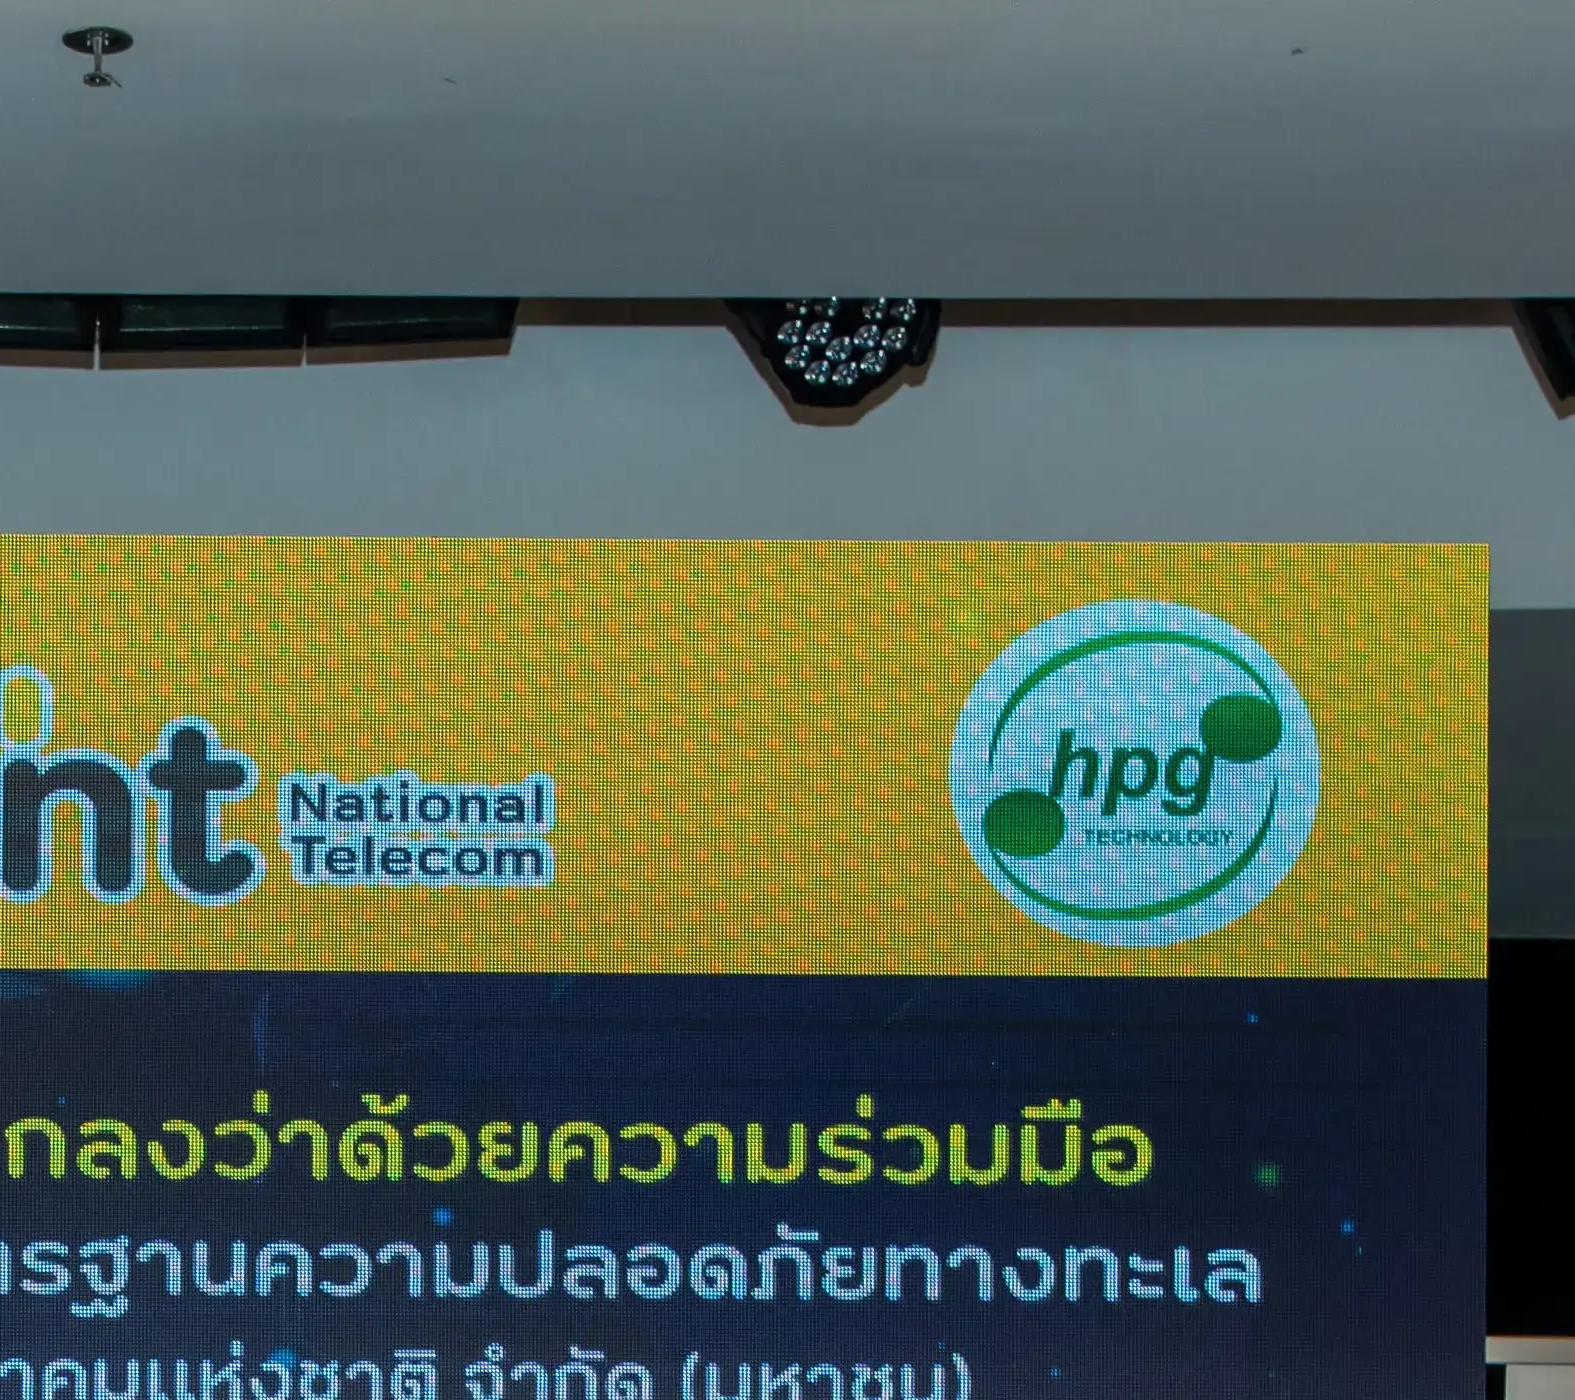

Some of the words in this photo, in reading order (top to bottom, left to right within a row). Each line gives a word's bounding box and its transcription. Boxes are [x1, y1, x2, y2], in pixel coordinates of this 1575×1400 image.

[1051, 728, 1217, 816] hpg
[1, 724, 257, 898] nt
[290, 781, 547, 825] National
[292, 834, 545, 878] Telecom
[1086, 829, 1237, 846] TECHNOLOGY
